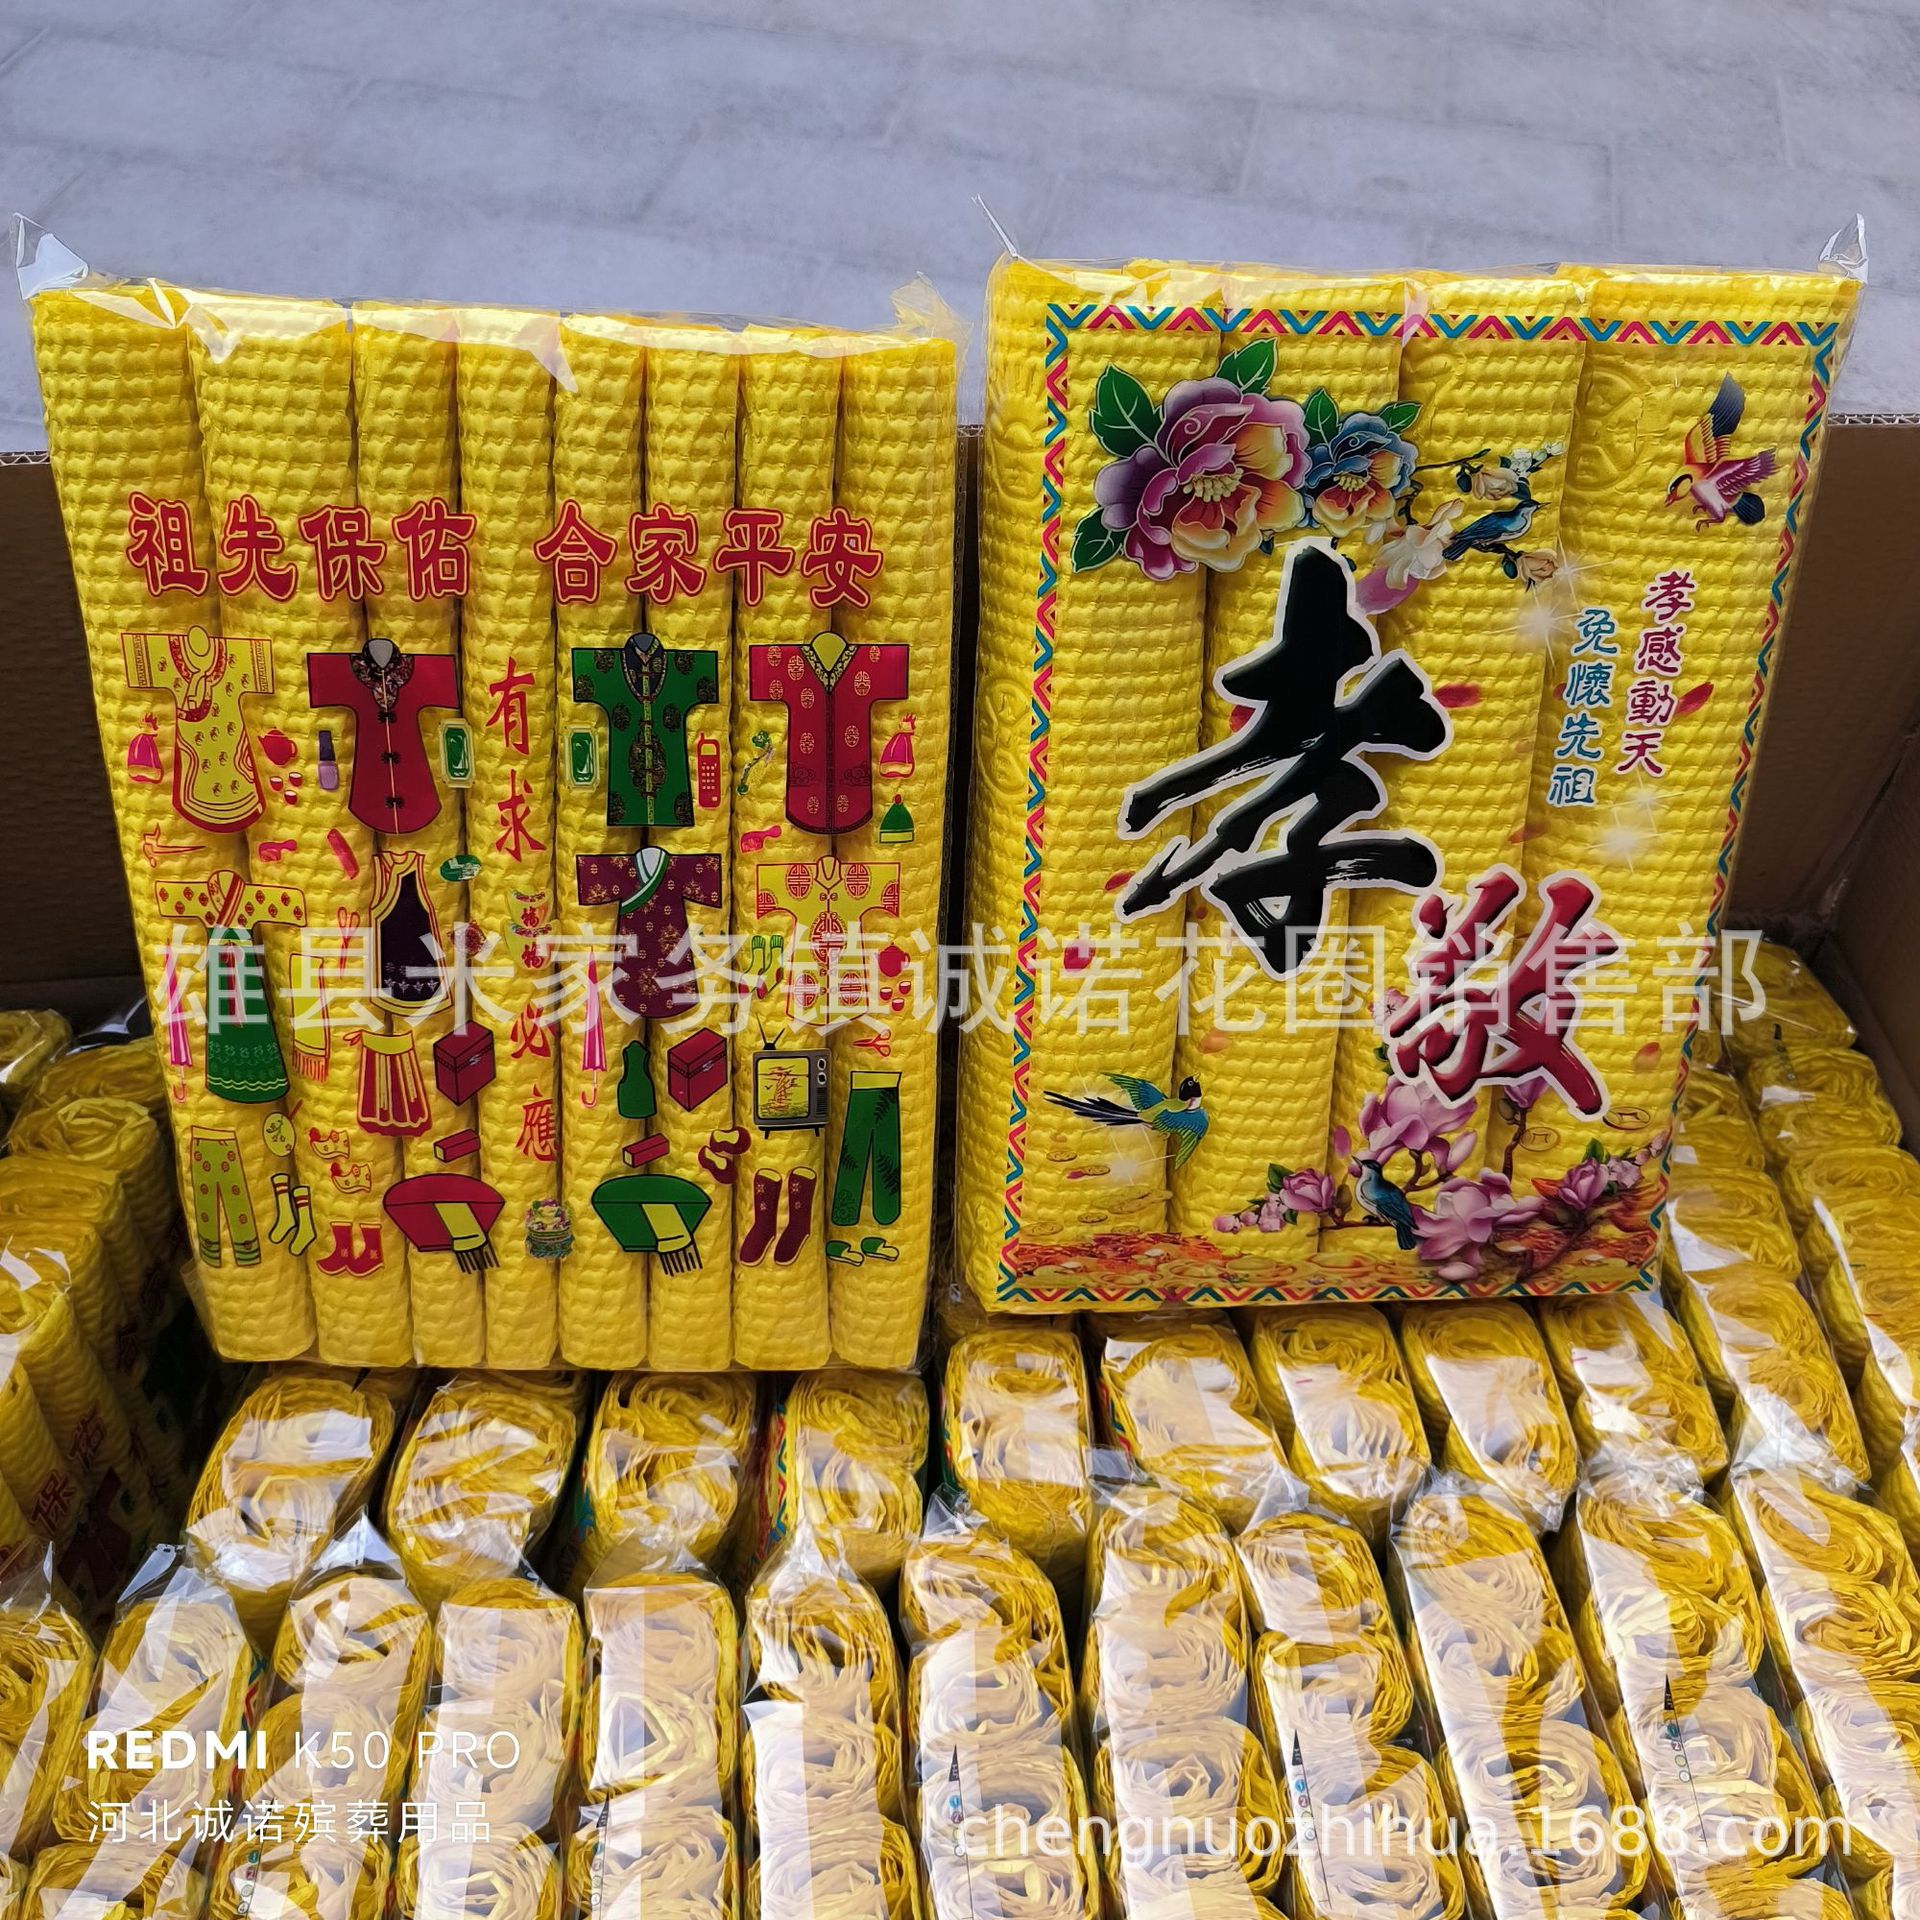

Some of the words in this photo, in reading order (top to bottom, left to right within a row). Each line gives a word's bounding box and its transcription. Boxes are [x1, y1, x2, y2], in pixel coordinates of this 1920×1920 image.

[126, 491, 477, 603] 祖先保佑
[534, 498, 885, 610] 合家平安
[1616, 570, 1696, 777] 孝感動天
